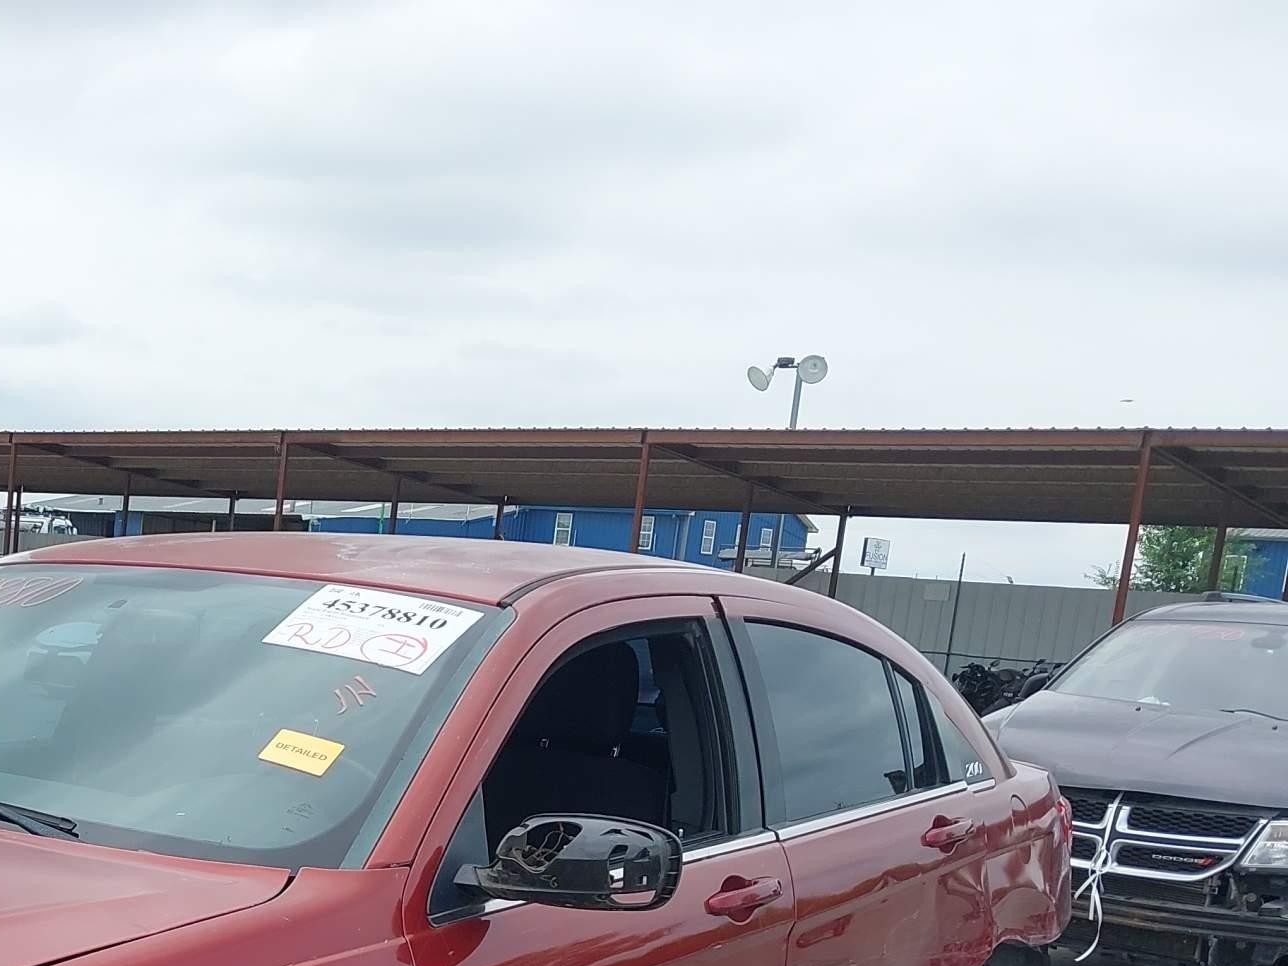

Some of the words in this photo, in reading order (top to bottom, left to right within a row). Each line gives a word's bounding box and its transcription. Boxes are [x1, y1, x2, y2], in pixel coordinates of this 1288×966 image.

[322, 598, 448, 630] 45378810
[275, 741, 328, 761] DETAILED
[1151, 854, 1201, 865] DODGE
